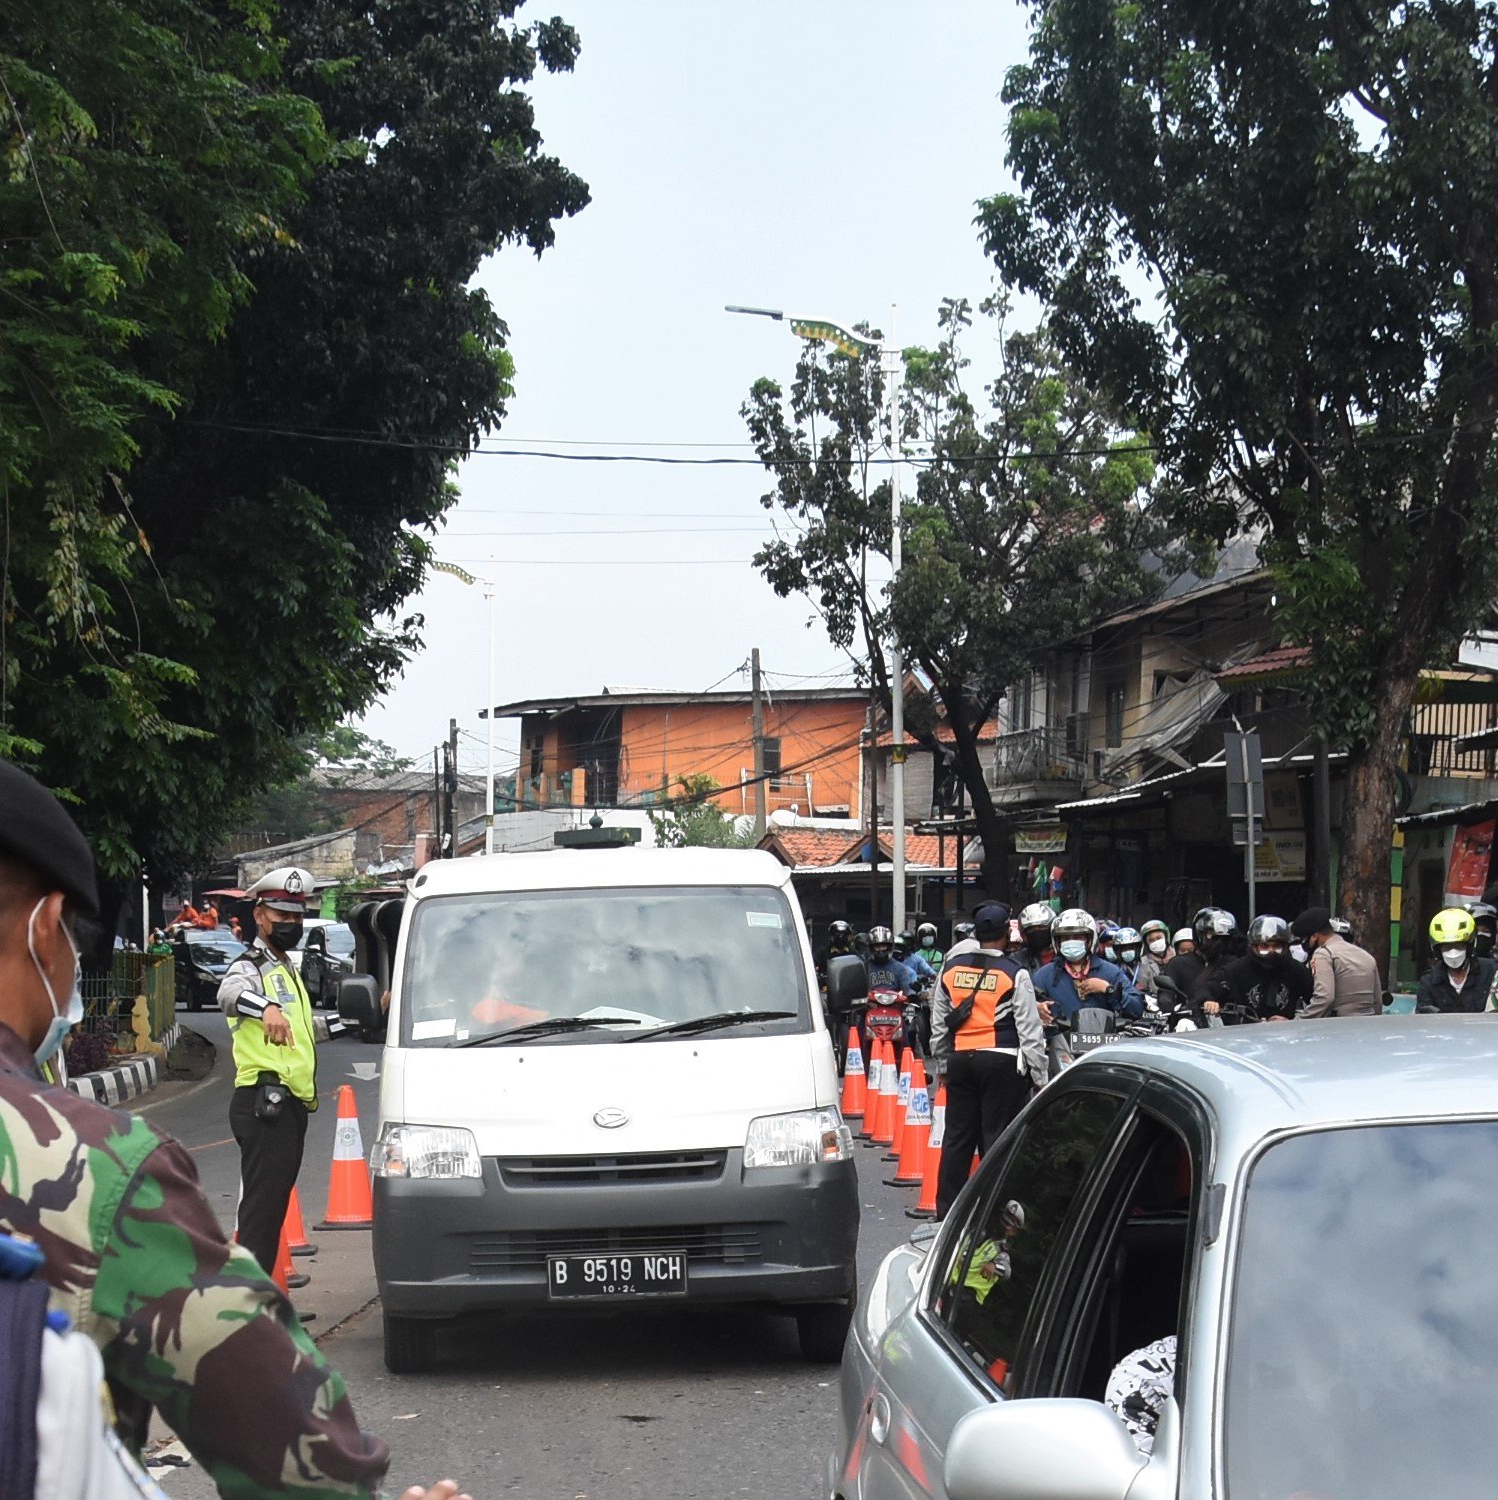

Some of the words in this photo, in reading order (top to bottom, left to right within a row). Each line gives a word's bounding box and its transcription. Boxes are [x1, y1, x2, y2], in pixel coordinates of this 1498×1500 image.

[555, 1261, 568, 1284] B
[583, 1258, 632, 1282] 9519
[644, 1256, 681, 1280] NCH
